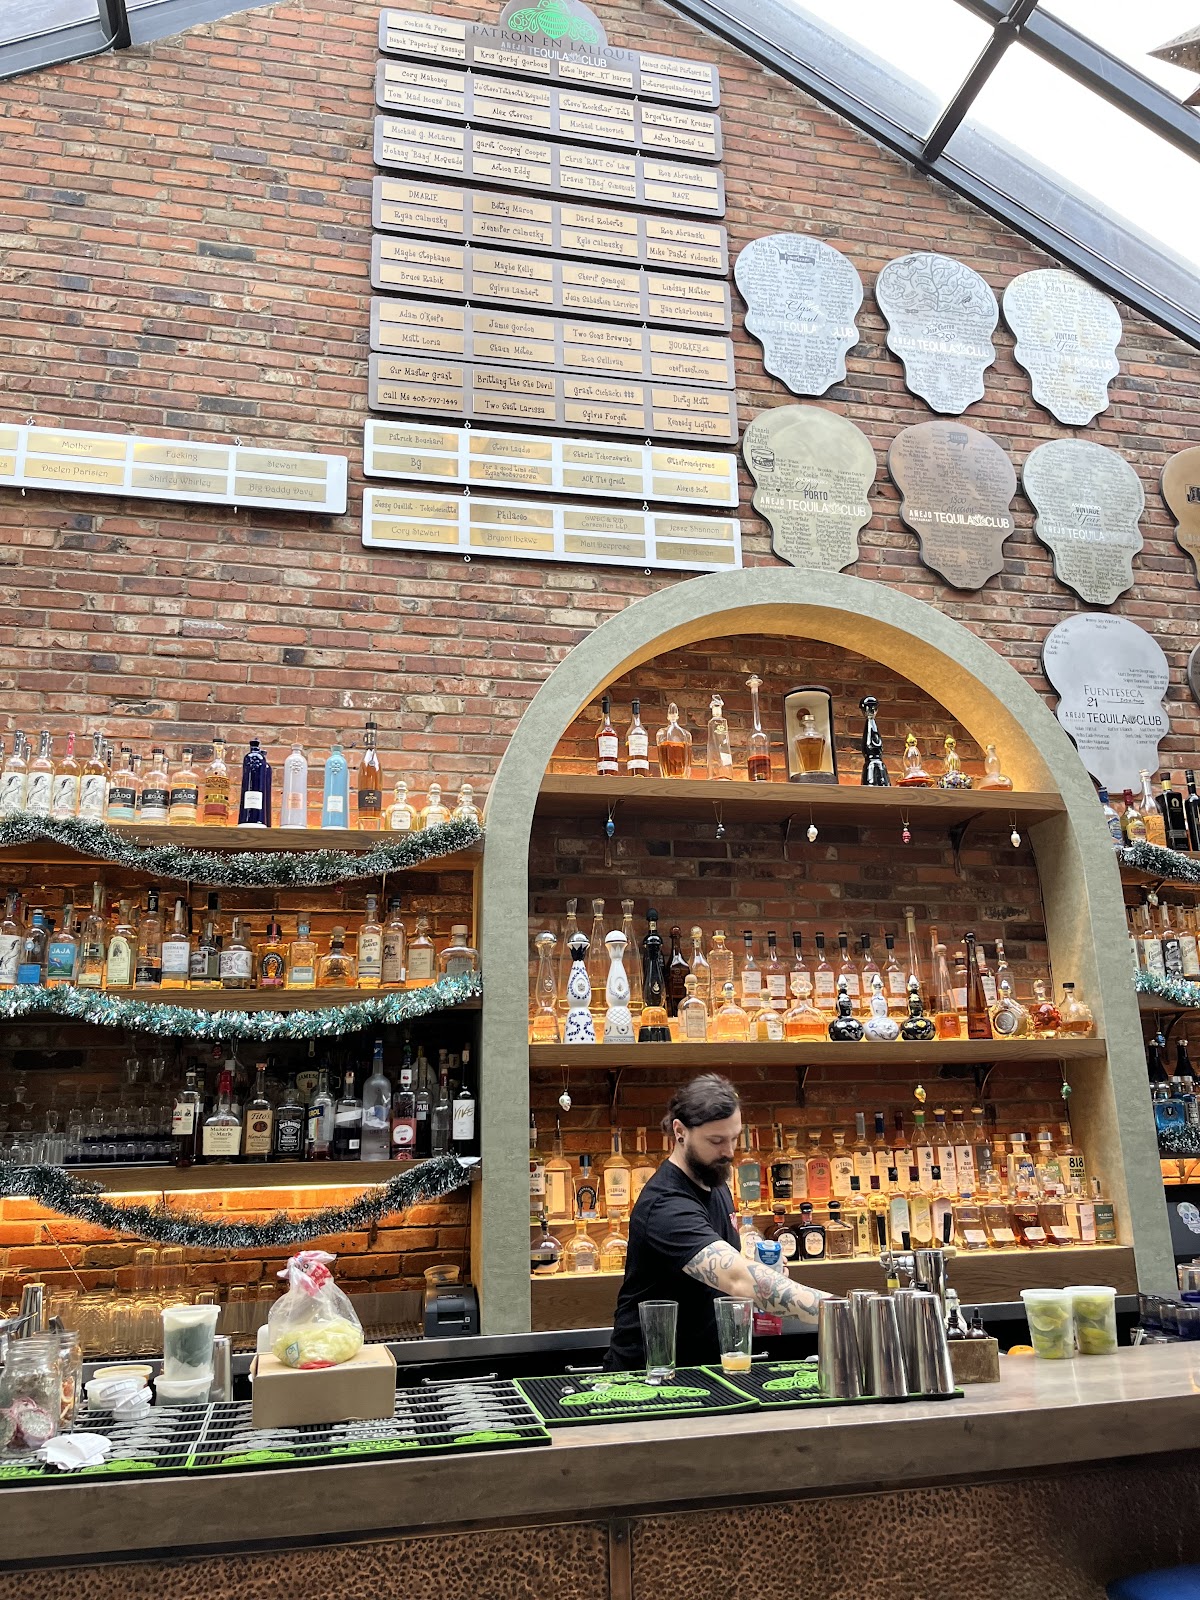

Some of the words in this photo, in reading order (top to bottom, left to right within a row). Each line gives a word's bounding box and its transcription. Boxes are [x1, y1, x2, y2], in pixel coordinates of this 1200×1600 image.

[528, 46, 569, 62] TEQUILA
[582, 56, 607, 68] CLUB
[918, 339, 957, 354] TEQUILA
[61, 440, 93, 451] Mother
[166, 450, 199, 462] Fucking
[804, 490, 828, 501] PORTO
[787, 499, 830, 514] TEQUILA
[840, 504, 867, 518] CLUB
[934, 511, 973, 525] TEQUILA
[986, 516, 1010, 529] CLUB
[1066, 527, 1106, 541] TEQUILA
[1083, 684, 1143, 698] FUENTESECA
[1086, 696, 1098, 708] 21
[1086, 712, 1128, 725] TEQUILA
[1136, 714, 1162, 726] CLUB
[109, 792, 131, 800] EGADO
[51, 946, 71, 955] JAJA
[1069, 1157, 1084, 1168] 818
